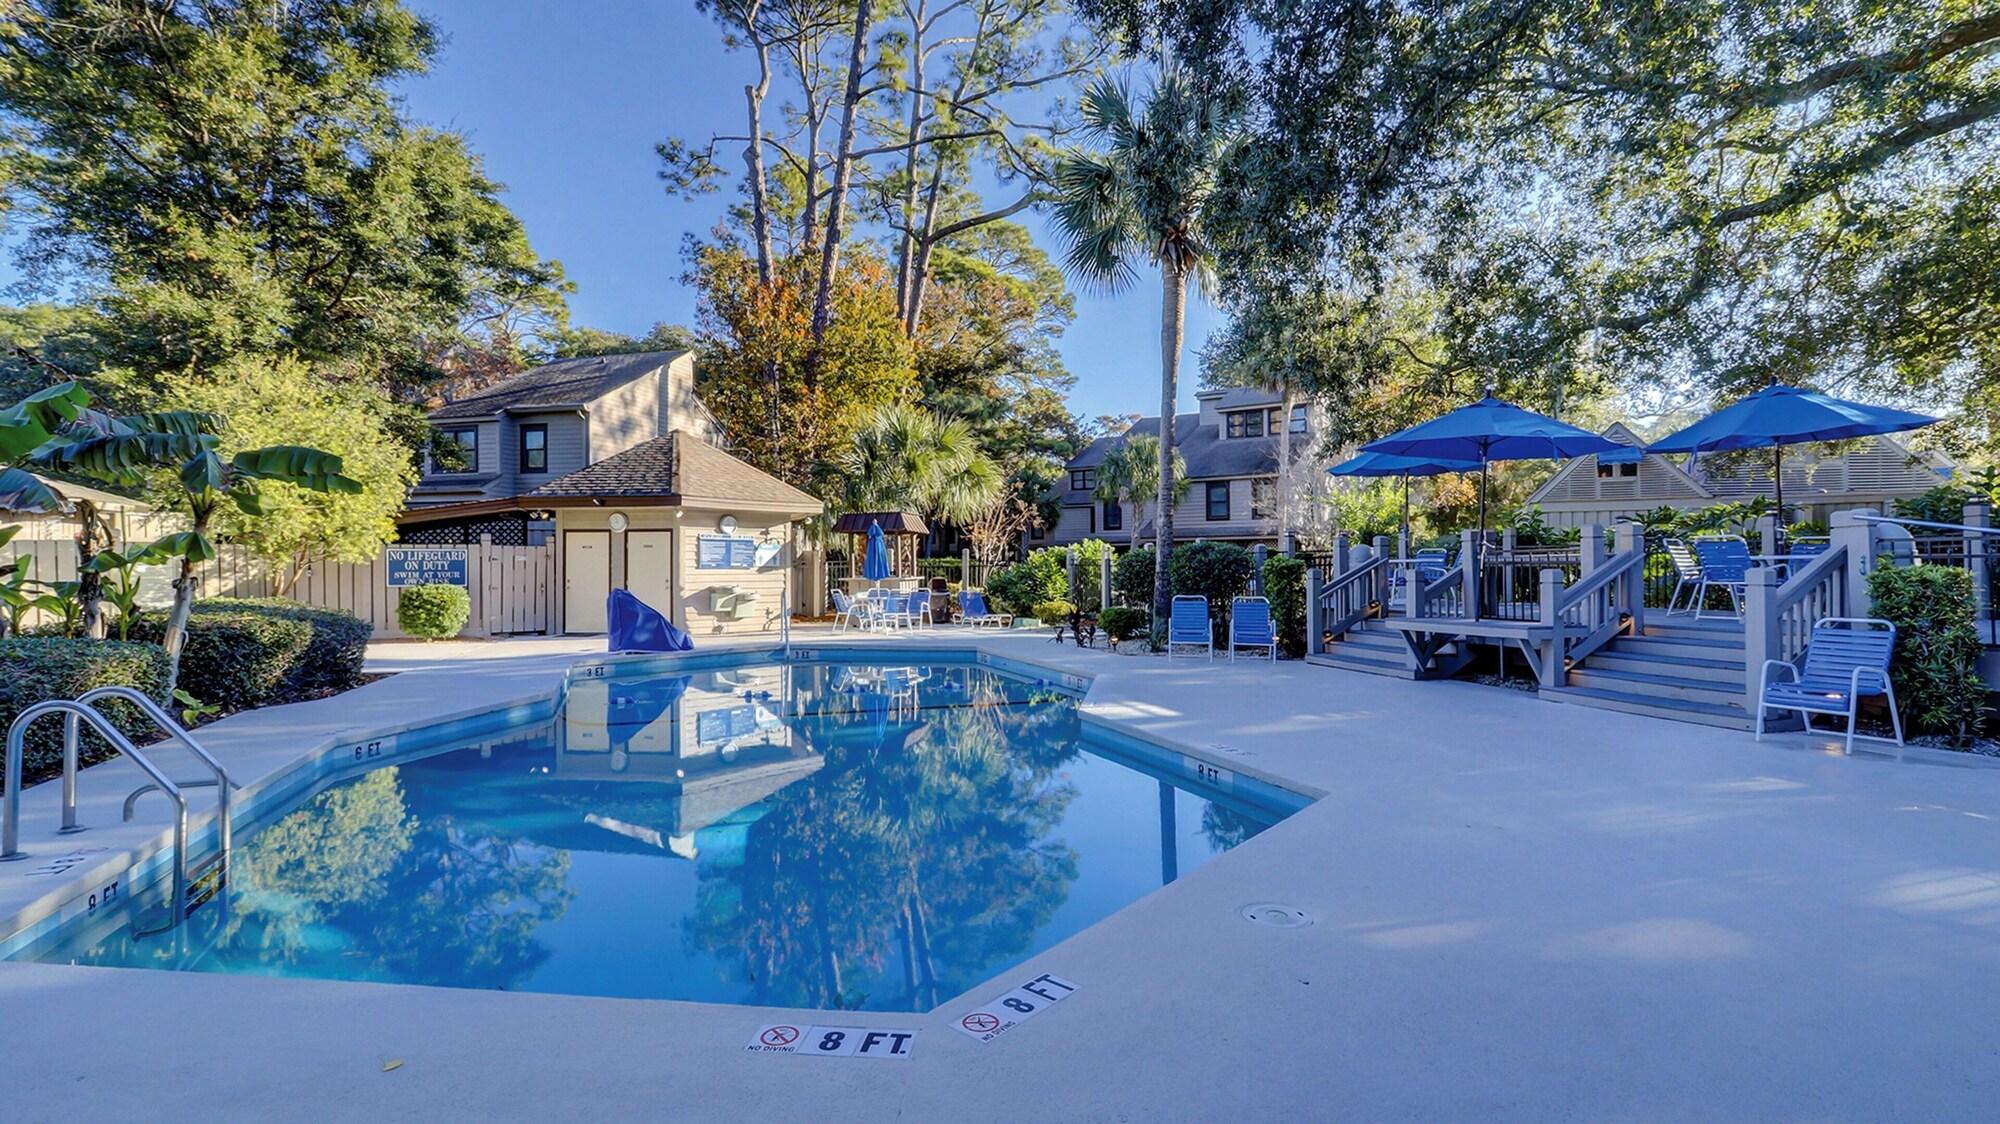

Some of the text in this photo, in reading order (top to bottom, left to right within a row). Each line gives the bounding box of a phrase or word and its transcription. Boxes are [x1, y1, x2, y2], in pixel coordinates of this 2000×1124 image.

[390, 551, 465, 561] NO LIFEGUARD
[404, 561, 450, 570] ON DUTY
[394, 571, 419, 579] SWIM
[1002, 974, 1074, 1013] 8 FT
[818, 1031, 912, 1054] 8 FT.
[763, 1045, 795, 1053] DIVING
